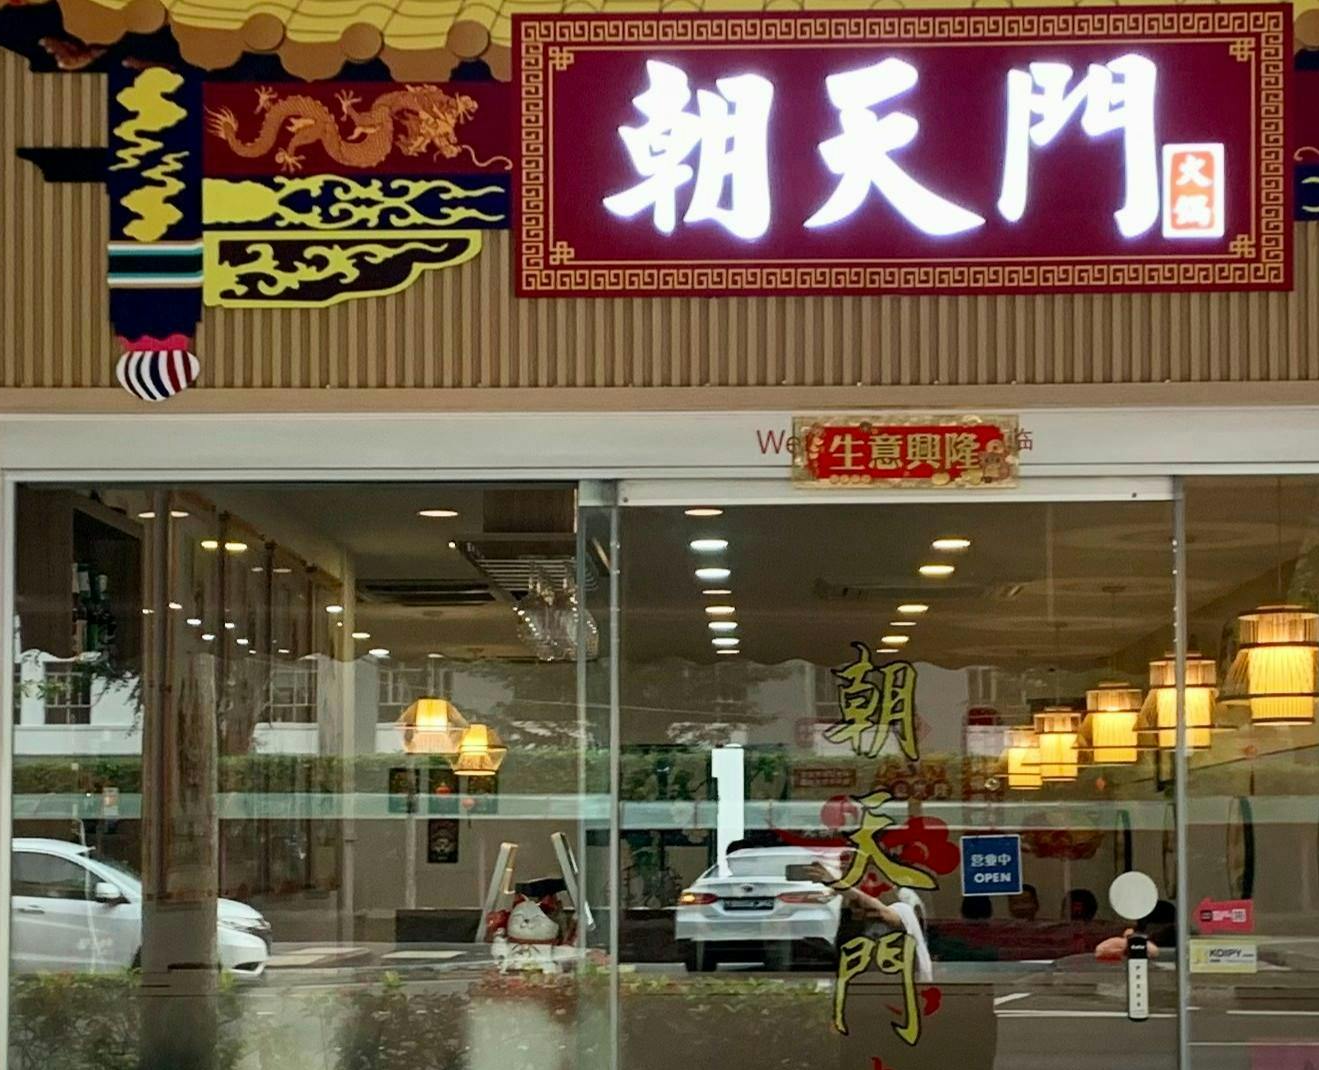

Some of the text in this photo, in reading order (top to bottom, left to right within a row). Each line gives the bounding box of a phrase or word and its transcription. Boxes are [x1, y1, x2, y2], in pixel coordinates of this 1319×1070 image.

[602, 52, 1160, 243] 朝天門
[829, 432, 982, 471] 生意興隆
[823, 641, 939, 1047] 朝天門
[974, 872, 1012, 884] OPEN
